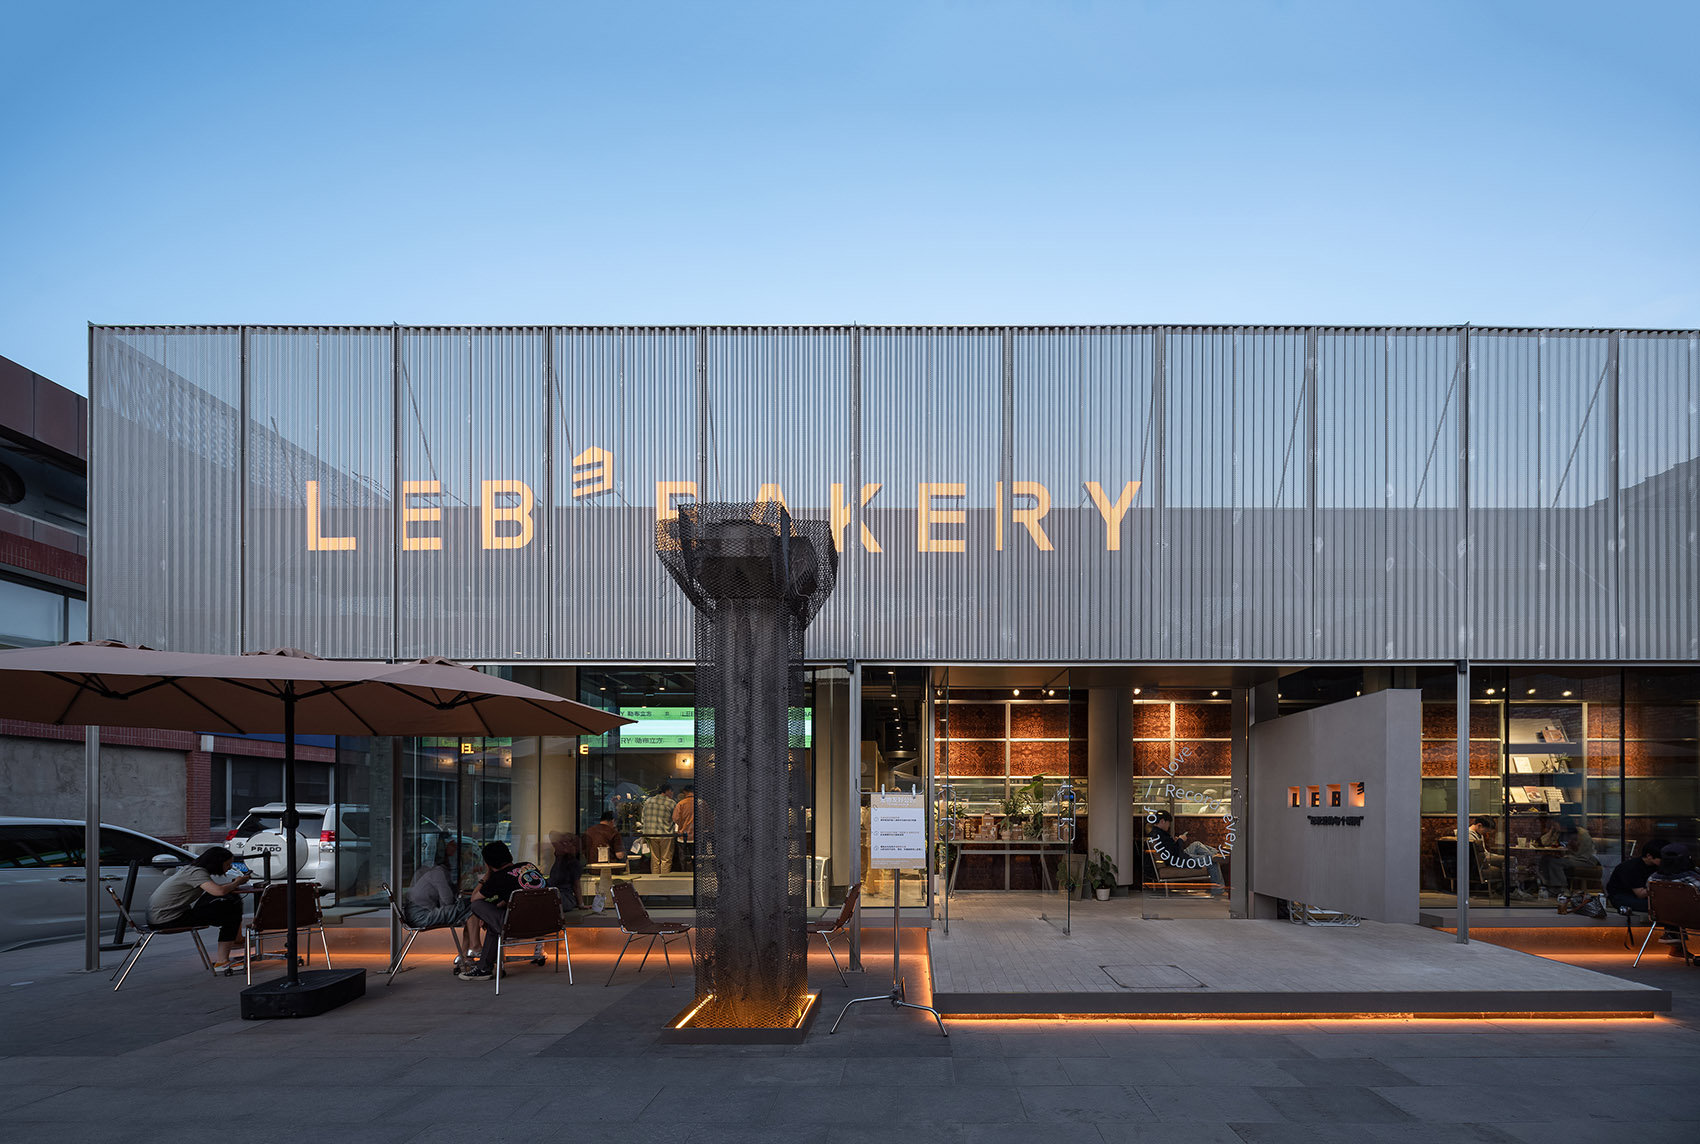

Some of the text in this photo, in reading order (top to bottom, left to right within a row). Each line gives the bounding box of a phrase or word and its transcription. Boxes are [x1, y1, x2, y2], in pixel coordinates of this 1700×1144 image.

[1161, 745, 1193, 777] love
[1165, 783, 1222, 811] Record
[1143, 805, 1158, 824] of
[1148, 834, 1213, 869] moment
[1218, 813, 1238, 860] every
